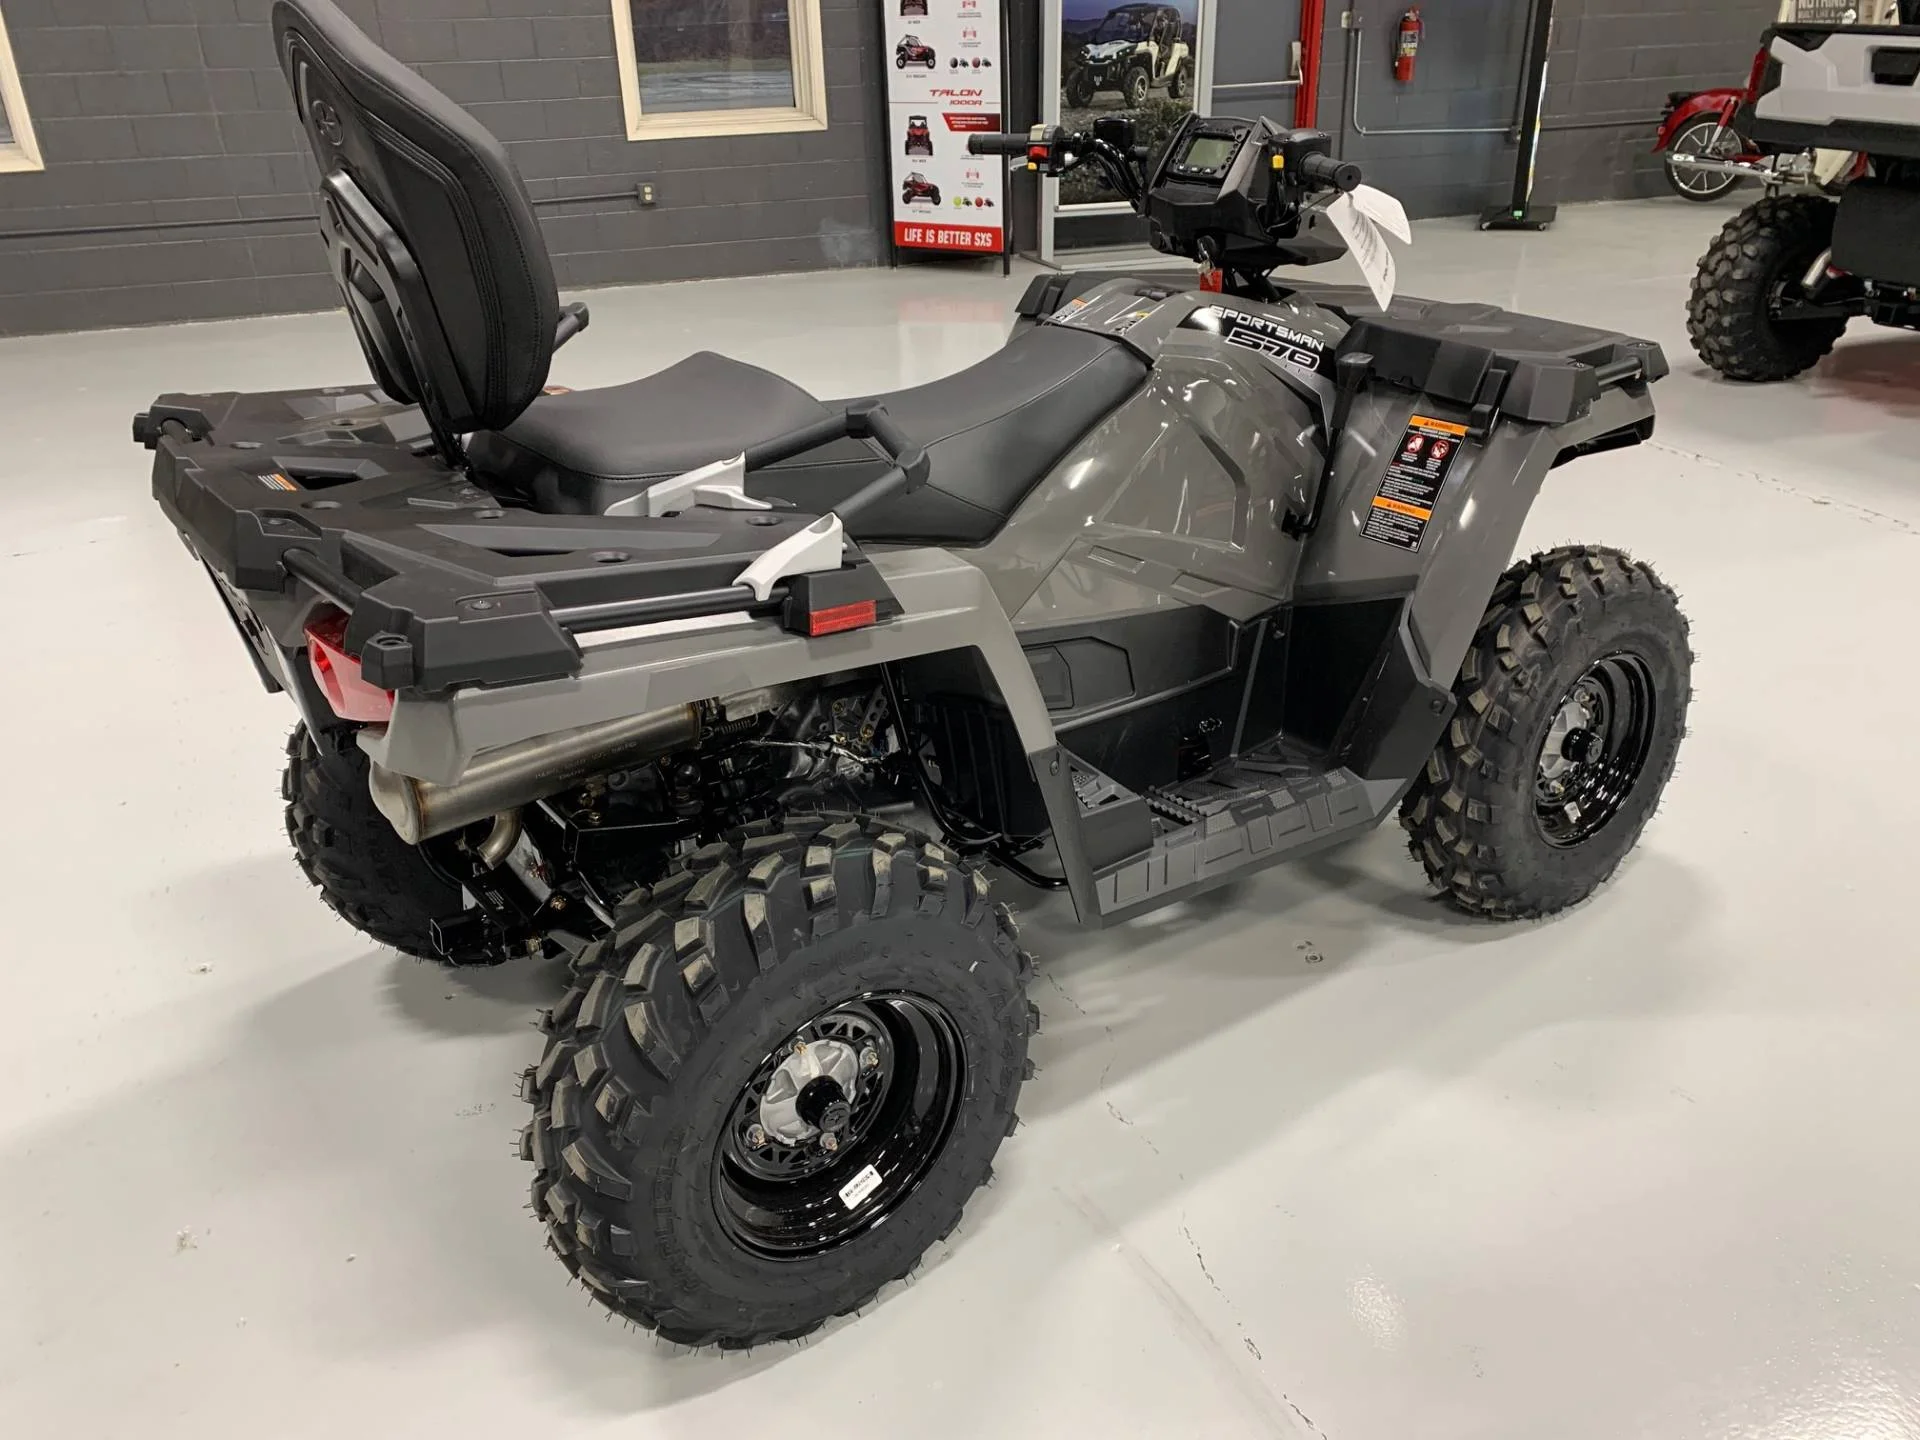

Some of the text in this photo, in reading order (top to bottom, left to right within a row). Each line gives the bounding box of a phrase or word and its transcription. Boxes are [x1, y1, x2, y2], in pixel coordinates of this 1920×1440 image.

[1798, 0, 1856, 8] NOTHINGS
[929, 89, 983, 97] TALON
[903, 227, 993, 247] LIFE IS BETTER SXS
[1209, 304, 1325, 352] SPORTSMAN
[1224, 327, 1320, 372] 570
